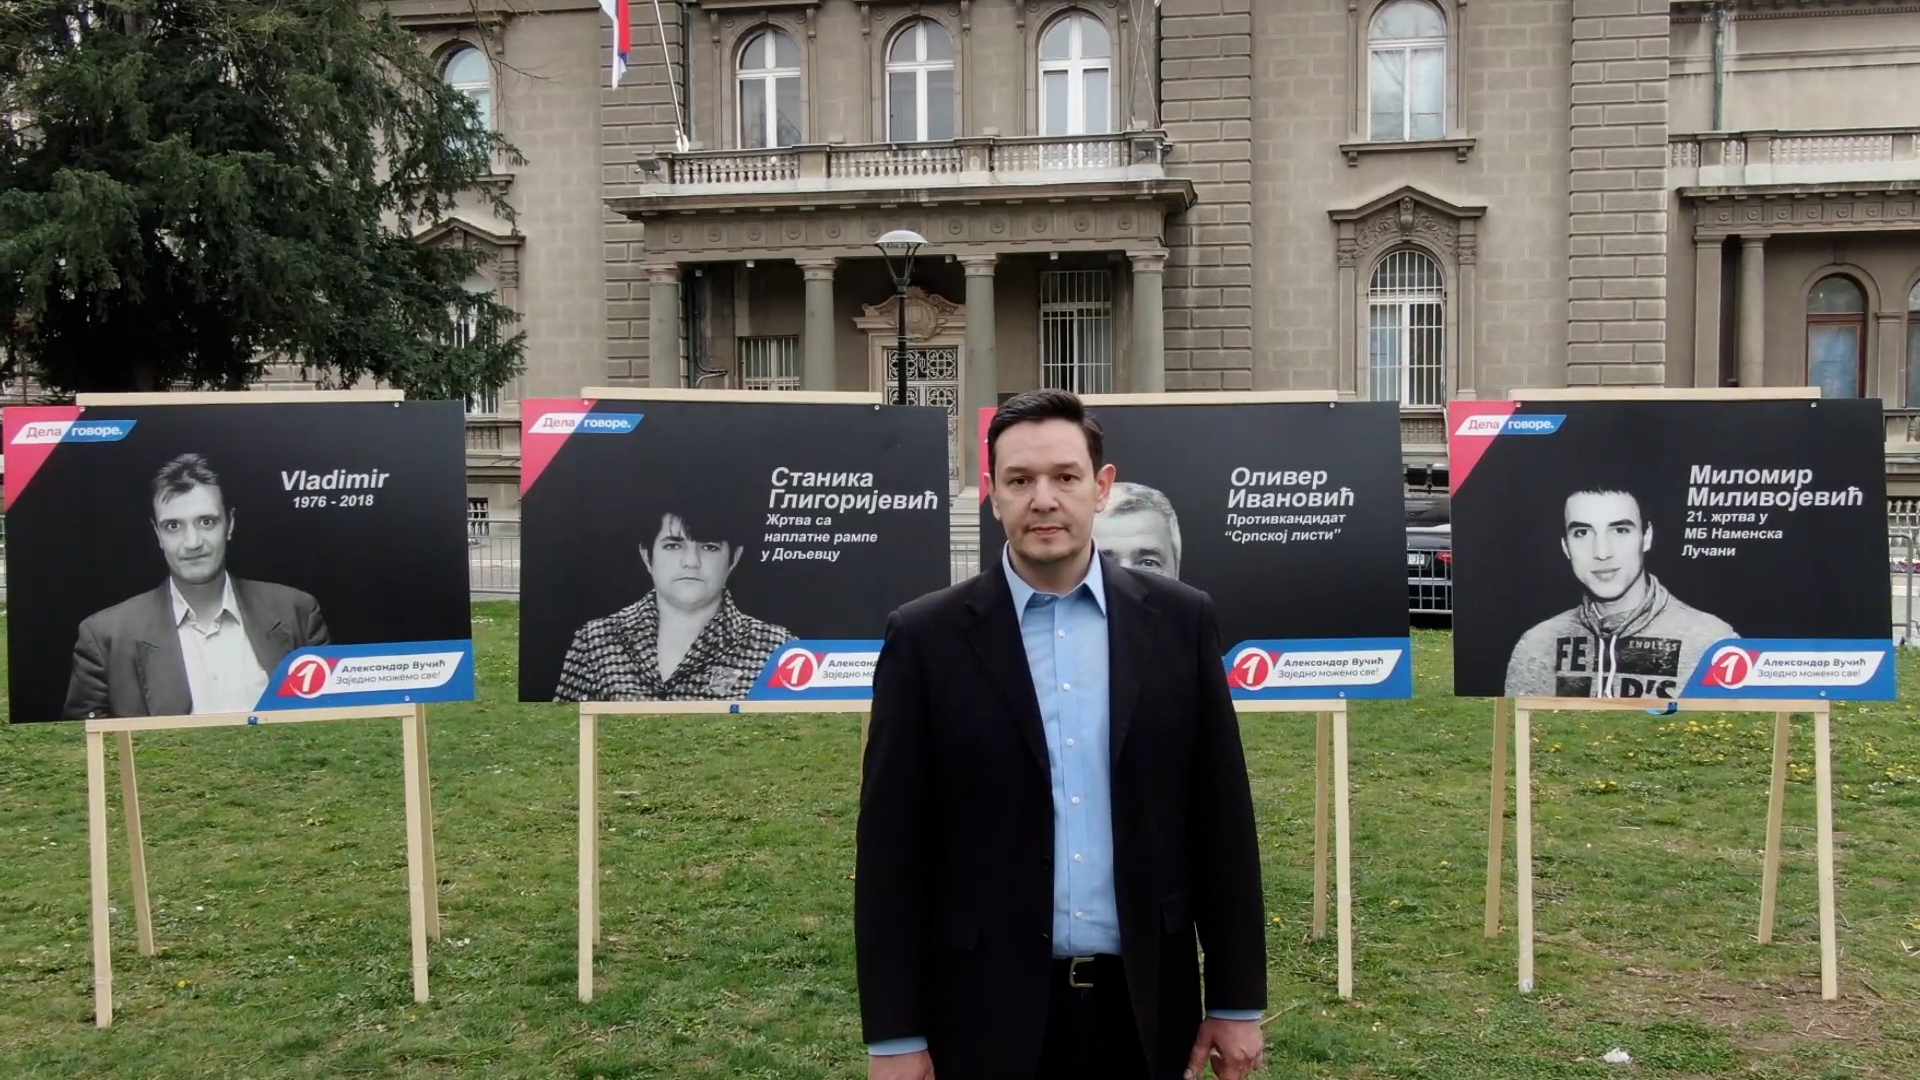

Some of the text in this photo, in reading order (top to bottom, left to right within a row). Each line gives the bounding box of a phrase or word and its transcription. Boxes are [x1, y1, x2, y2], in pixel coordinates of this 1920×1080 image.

[543, 417, 632, 430] Дела говоре.
[1468, 419, 1555, 431] Дела говоре.
[26, 426, 124, 439] Дела говоре.
[281, 468, 391, 491] Vladimir
[771, 466, 875, 488] Станика
[1230, 466, 1328, 490] Оливер
[1689, 464, 1814, 490] Миломир
[293, 496, 328, 509] 1976
[339, 494, 375, 508] 2018
[768, 488, 939, 515] Глигоријевић
[1227, 486, 1355, 509] Ивановић
[1686, 485, 1864, 512] Миливојевић
[765, 513, 833, 528] Жртва са
[1226, 513, 1347, 528] Противкандидат
[1686, 510, 1769, 525] 21. жртва у
[763, 532, 879, 545] наплатне рампе
[1684, 527, 1784, 540] МБ Наменска
[760, 547, 841, 563] у Дољевцу
[1681, 544, 1737, 559] Лучани
[1629, 639, 1679, 651] ENDLESS
[341, 659, 446, 674] Александар Вучић
[1241, 656, 1262, 684] 1
[1283, 656, 1384, 669] Александар Вучић
[1719, 654, 1740, 683] 1
[1762, 658, 1867, 669] Александар Вучић
[296, 664, 318, 692] 1
[786, 656, 807, 685] 1
[822, 670, 861, 680] Заједно
[1278, 667, 1380, 680] Заједно можемо све!
[1757, 669, 1862, 680] Заједно можемо све!
[335, 671, 441, 686] Заједно можемо све!
